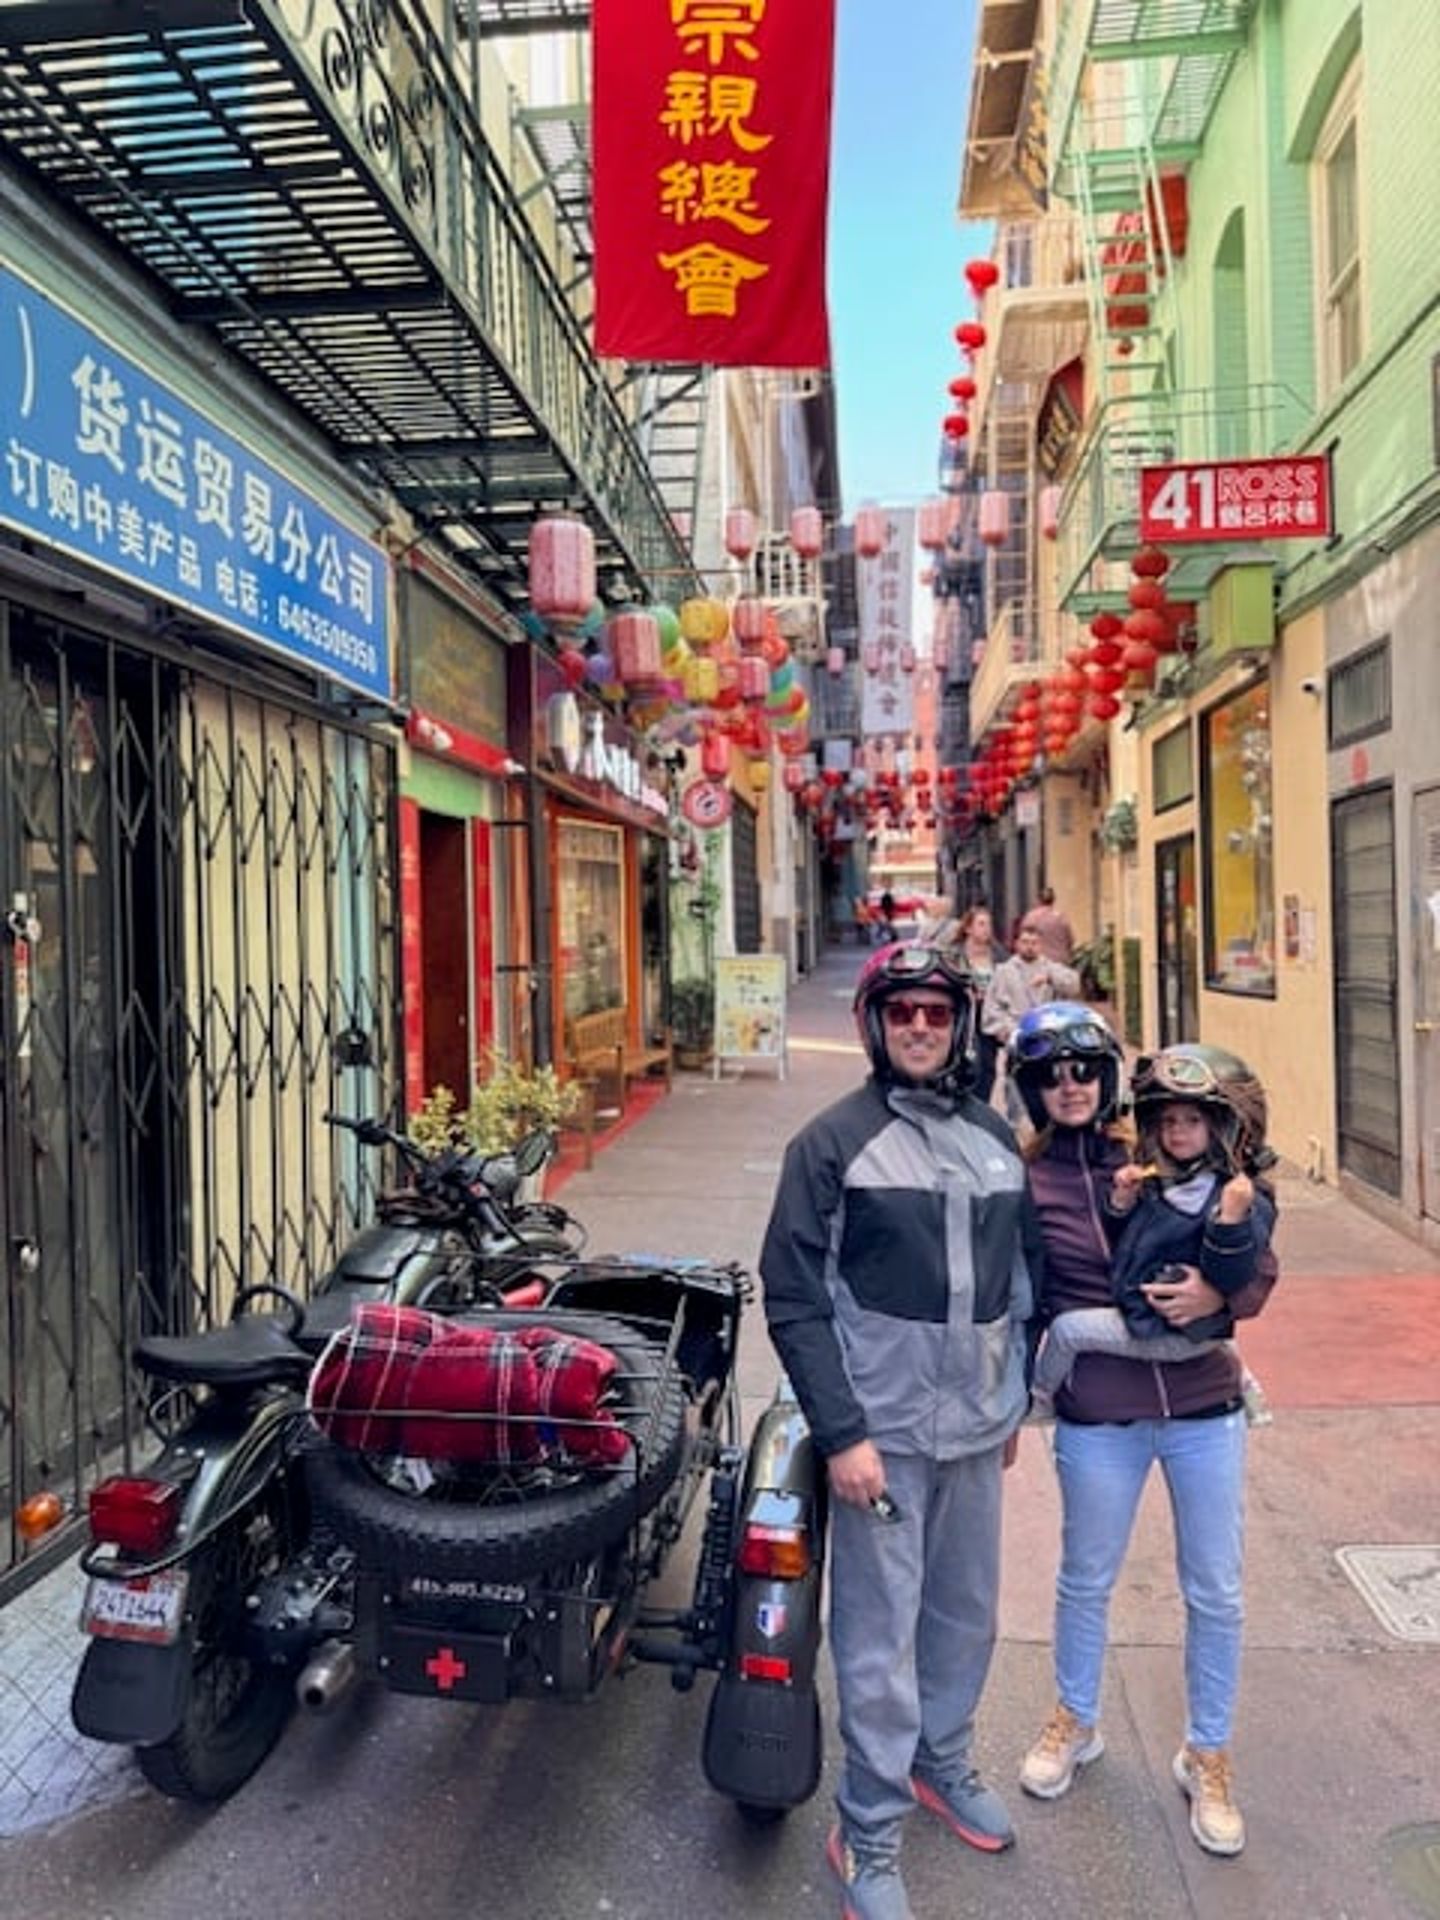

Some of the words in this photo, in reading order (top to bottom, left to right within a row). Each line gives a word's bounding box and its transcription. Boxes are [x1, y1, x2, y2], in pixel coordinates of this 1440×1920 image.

[7, 438, 201, 587] 订购中美产品
[1149, 470, 1216, 529] 41
[1218, 467, 1318, 502] ROSS
